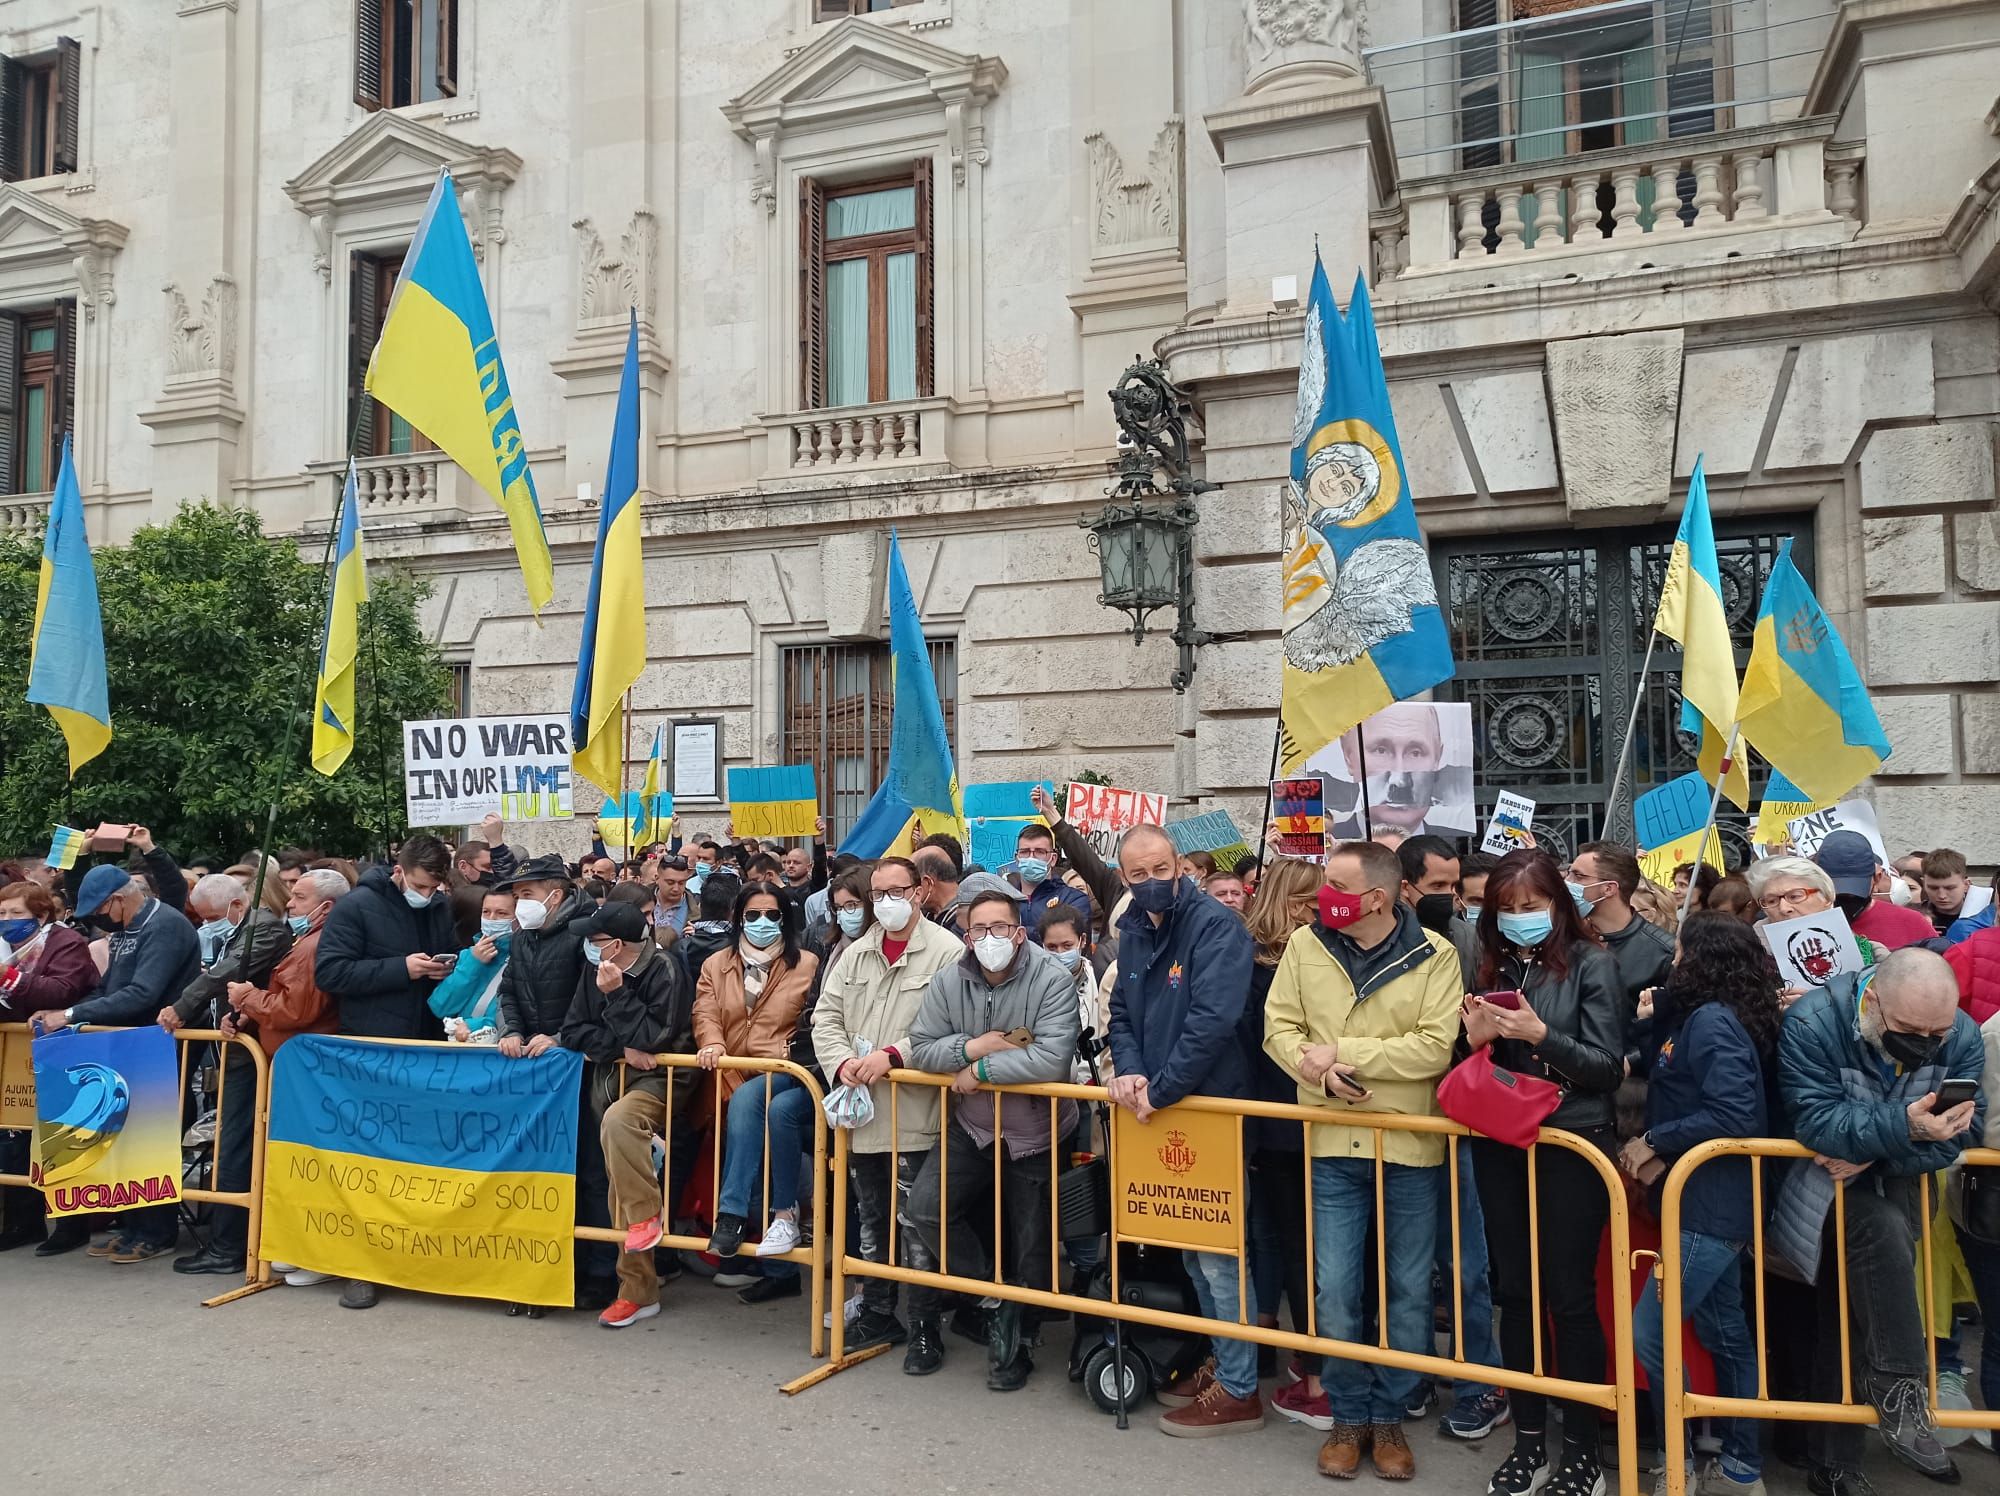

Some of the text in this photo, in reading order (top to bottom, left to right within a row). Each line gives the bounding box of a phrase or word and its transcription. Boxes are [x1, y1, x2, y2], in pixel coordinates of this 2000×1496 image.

[412, 723, 568, 760] NO WAR
[408, 768, 459, 801] IN
[463, 767, 498, 797] OUR
[500, 765, 573, 820] HOME
[975, 788, 1013, 811] STOP
[1069, 783, 1163, 826] PUTIN
[1273, 781, 1320, 798] STOP
[1500, 797, 1521, 808] HANDS
[738, 802, 806, 836] ASESINO
[1642, 778, 1697, 844] HELP
[972, 830, 1018, 863] SAV
[1280, 836, 1318, 846] RUSSIAN
[303, 1039, 419, 1087] SERRAR
[426, 1052, 460, 1094] EL
[5, 1098, 16, 1107] DE
[315, 1095, 572, 1154] SOBRE UCRANIA
[55, 1174, 177, 1212] UCRANIA
[289, 1155, 560, 1213] NO NOS DEJEIS SOLO
[1127, 1182, 1232, 1205] AJUNTAMENT
[1127, 1200, 1232, 1225] DE VALÈNCIA
[305, 1209, 562, 1266] NOS ESTAN MATANDO
